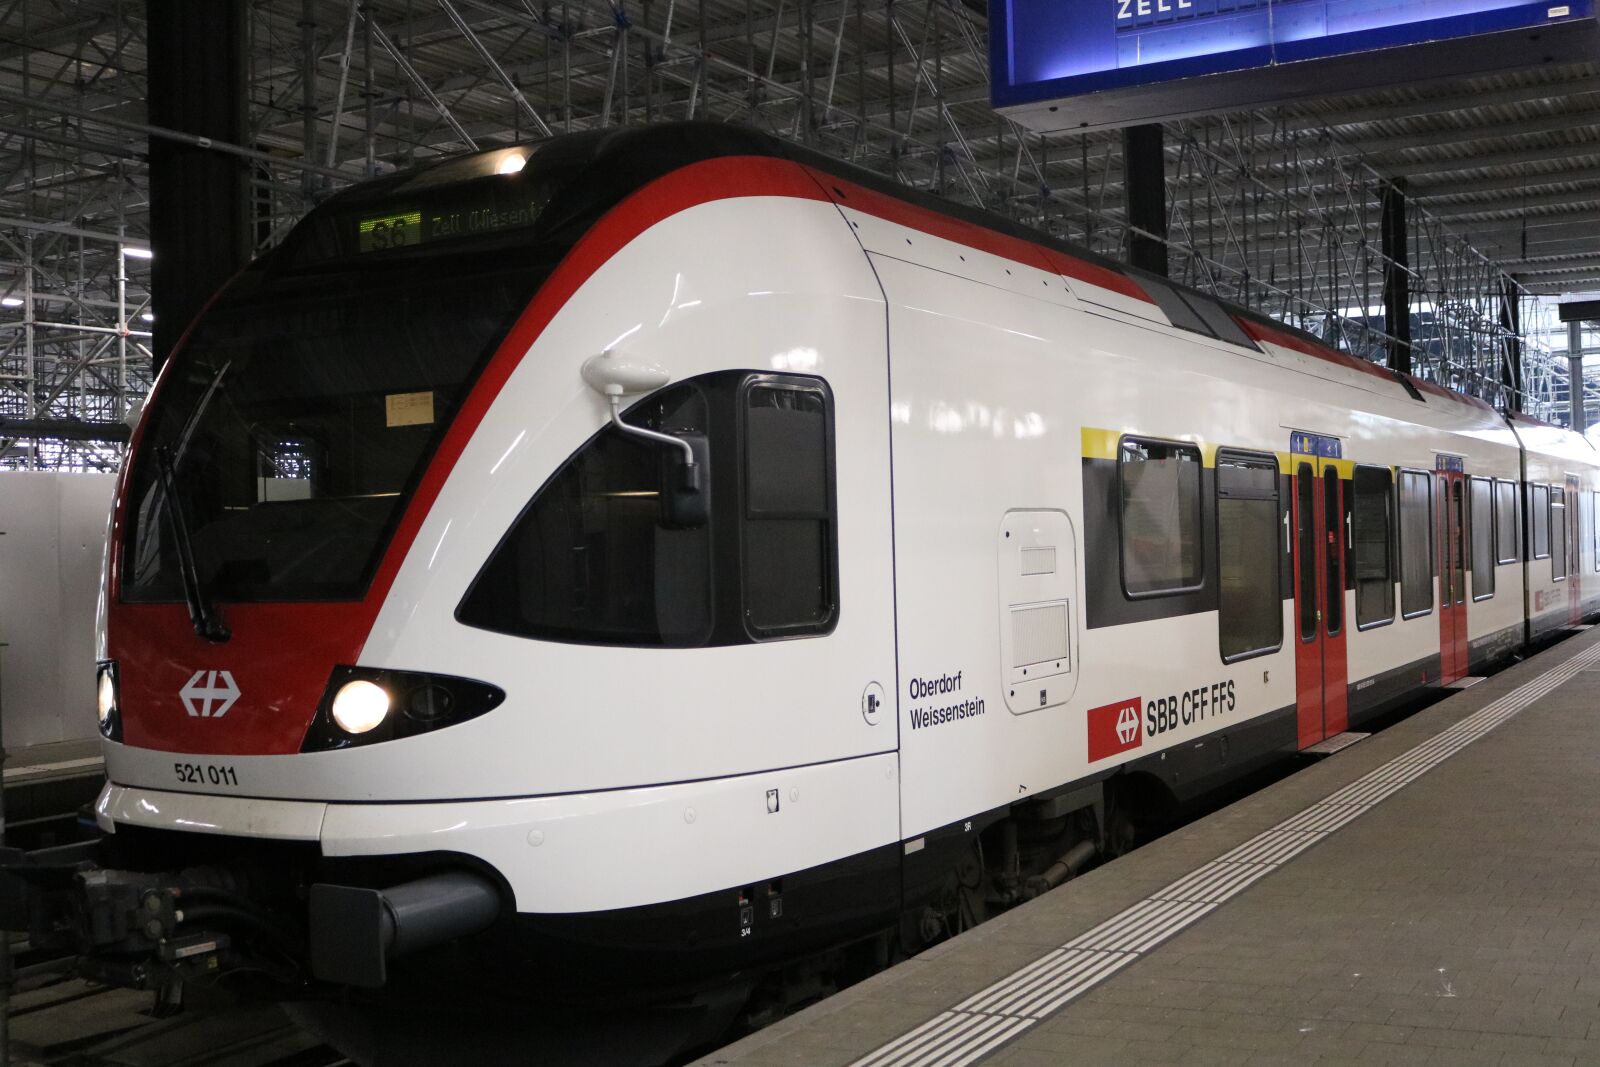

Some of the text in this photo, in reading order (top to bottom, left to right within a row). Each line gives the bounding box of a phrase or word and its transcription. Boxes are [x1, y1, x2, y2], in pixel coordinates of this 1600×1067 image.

[371, 217, 406, 249] S6
[1283, 510, 1291, 553] 1
[1346, 511, 1352, 549] 1
[909, 670, 962, 700] Oberdorf
[910, 696, 985, 730] Weissenstein
[1147, 679, 1235, 738] SBB CFF FFS
[174, 763, 238, 786] 521 011
